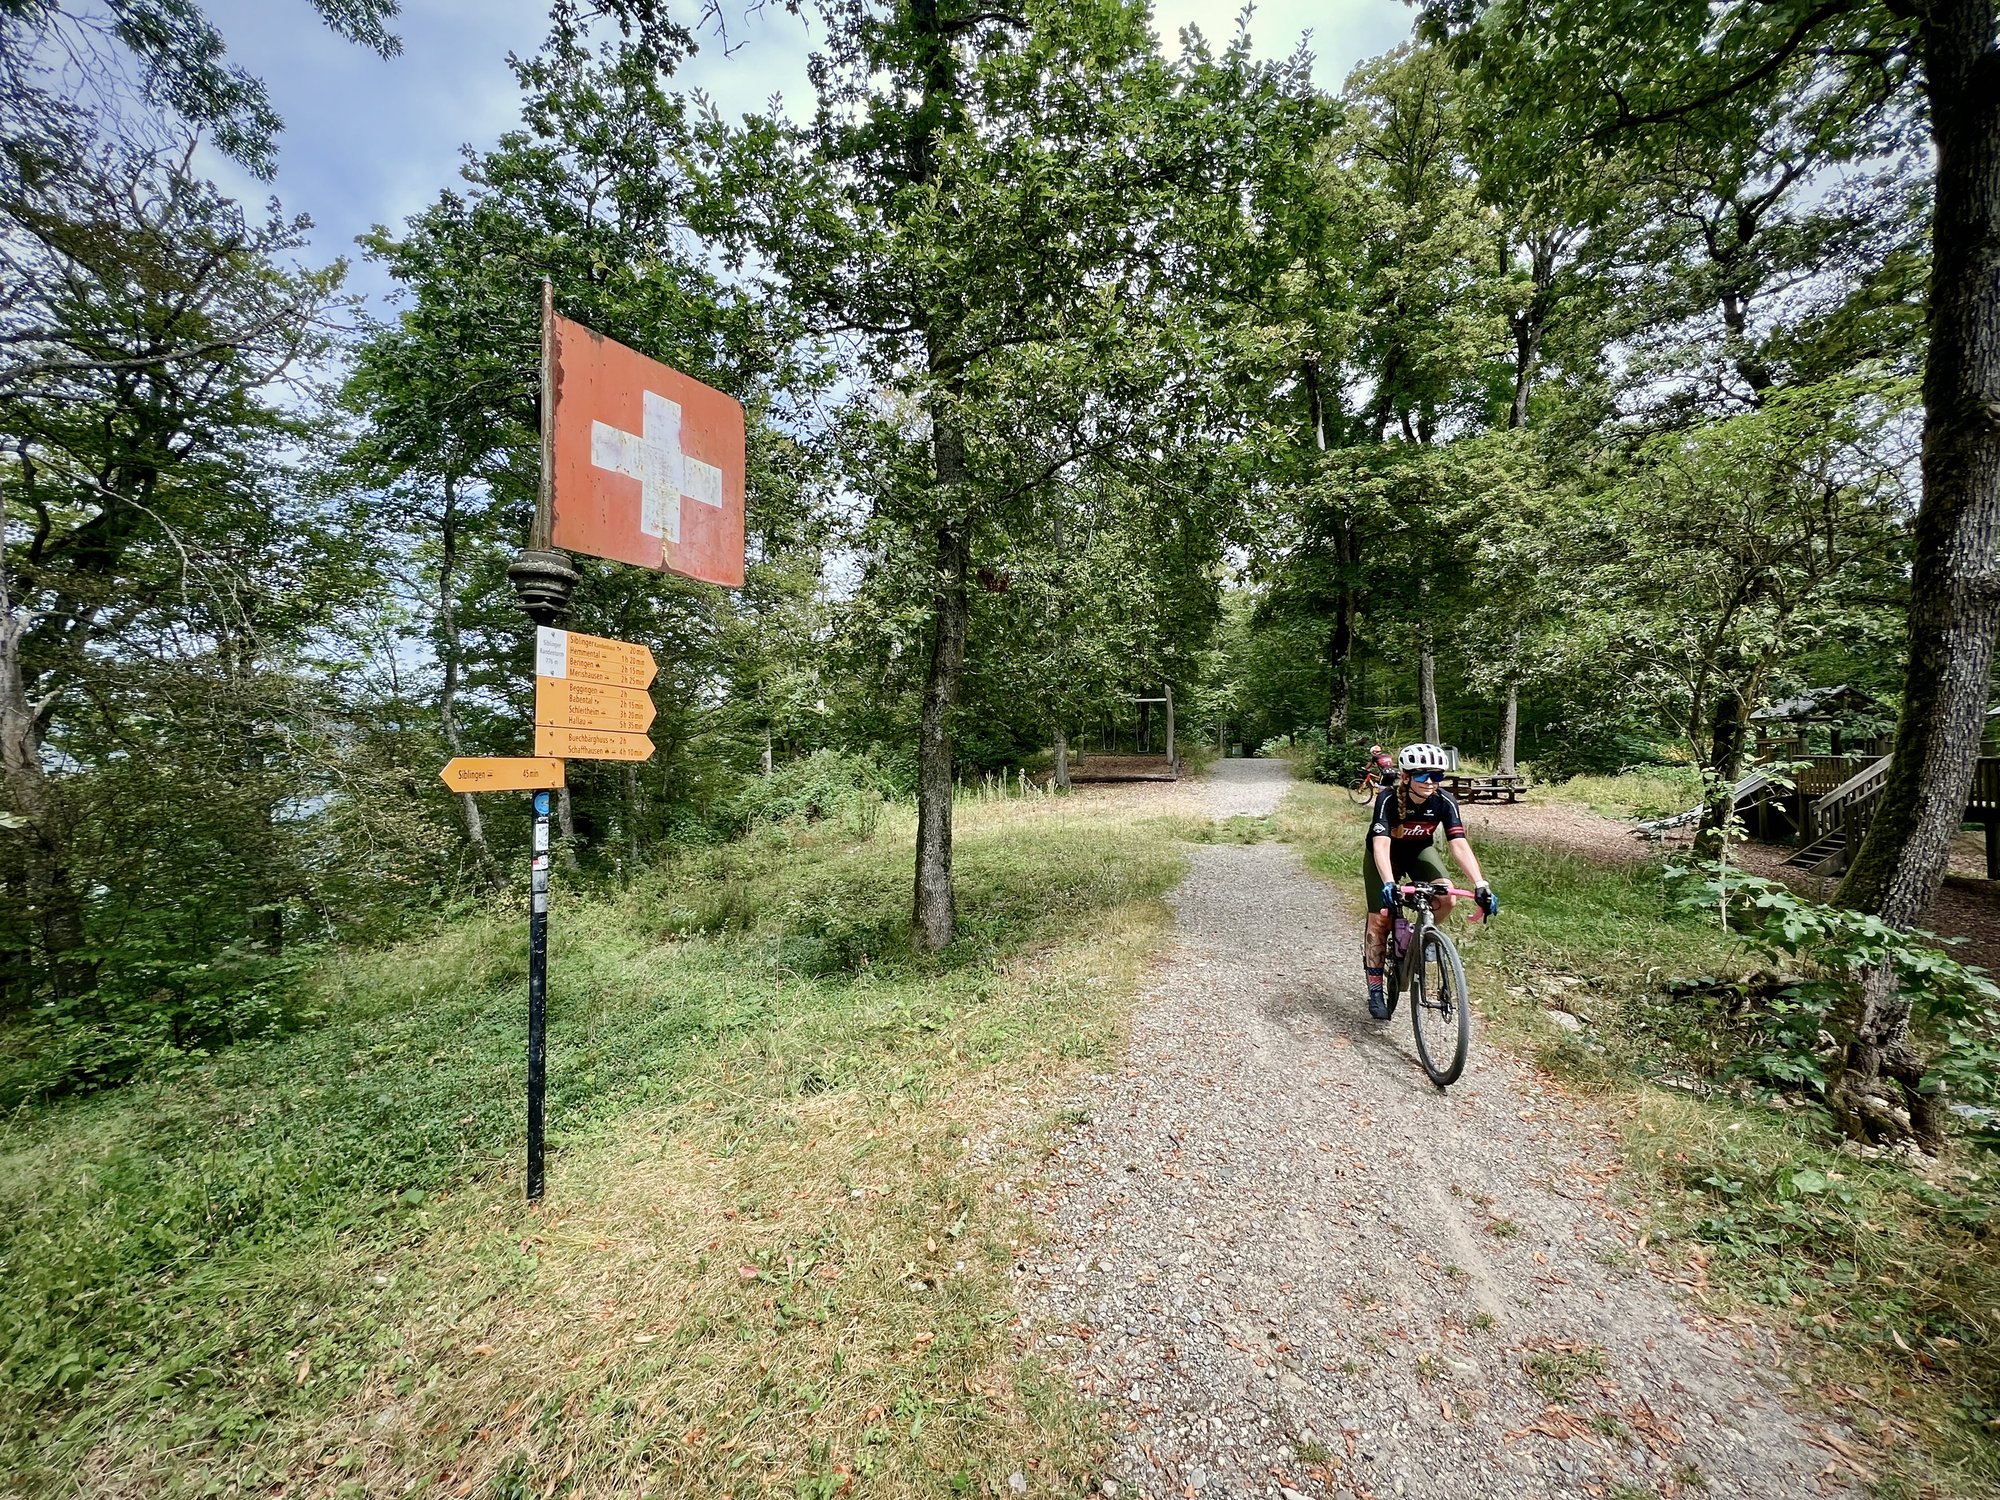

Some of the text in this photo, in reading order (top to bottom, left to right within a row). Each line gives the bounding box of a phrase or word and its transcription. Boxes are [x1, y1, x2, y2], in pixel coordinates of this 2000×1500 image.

[570, 636, 594, 648] Siblinger
[570, 646, 600, 658] Hemmental
[570, 657, 594, 669] Beringen
[570, 668, 603, 680] Merishausen
[569, 683, 598, 696] Beggingen
[569, 694, 592, 704] Babental
[568, 705, 600, 716] Schleitheim
[568, 716, 586, 725] Hallau
[568, 745, 603, 755] Schaffhausen
[458, 769, 486, 782] Siblingen
